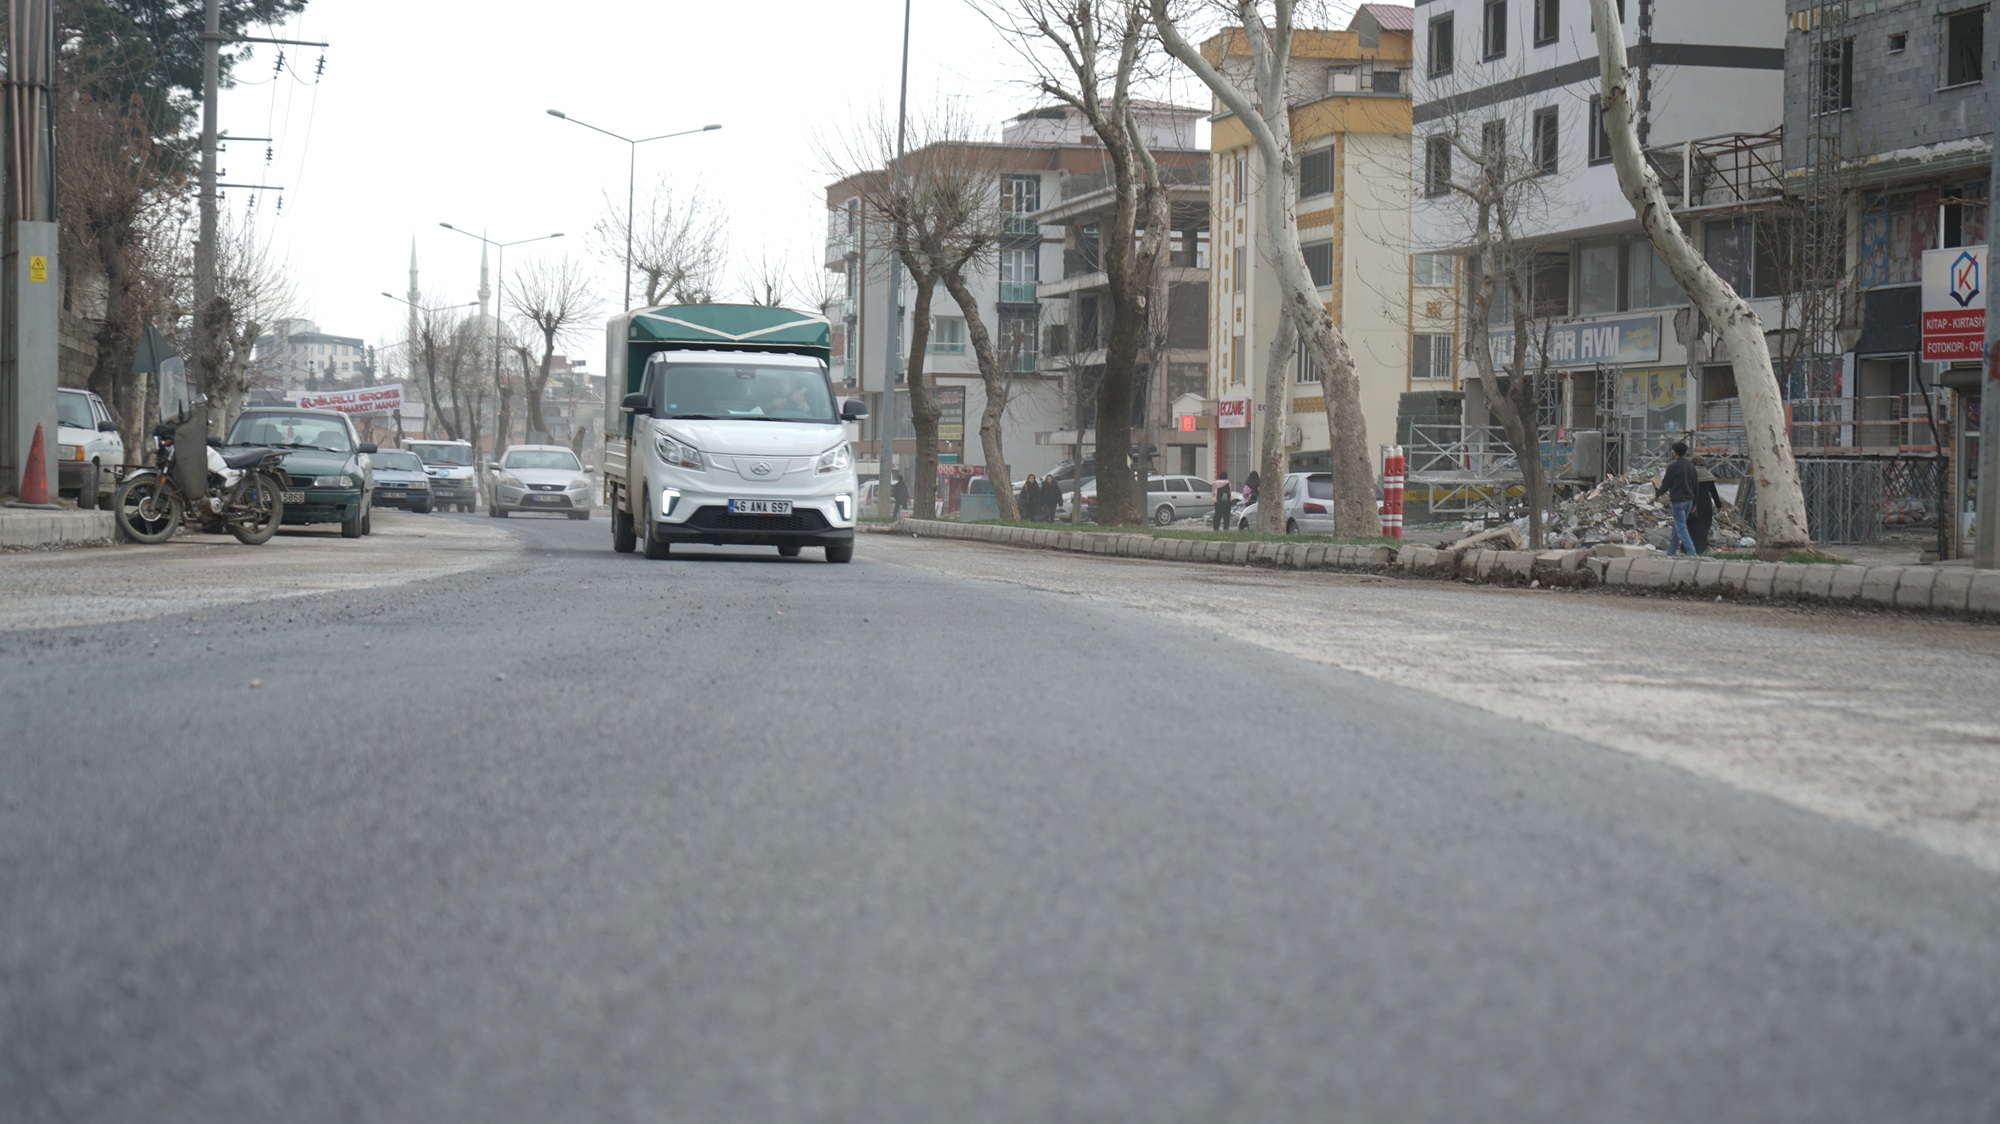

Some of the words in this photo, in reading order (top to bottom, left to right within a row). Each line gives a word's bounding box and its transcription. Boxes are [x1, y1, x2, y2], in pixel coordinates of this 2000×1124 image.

[1926, 317, 1948, 329] KİTAP
[1581, 326, 1620, 358] AVM
[1927, 339, 1964, 353] FOTOKOPİ
[343, 402, 373, 413] MARKET
[1220, 400, 1244, 416] ECZANE
[734, 501, 746, 511] 46
[750, 501, 768, 512] ANA
[771, 502, 789, 513] 697
